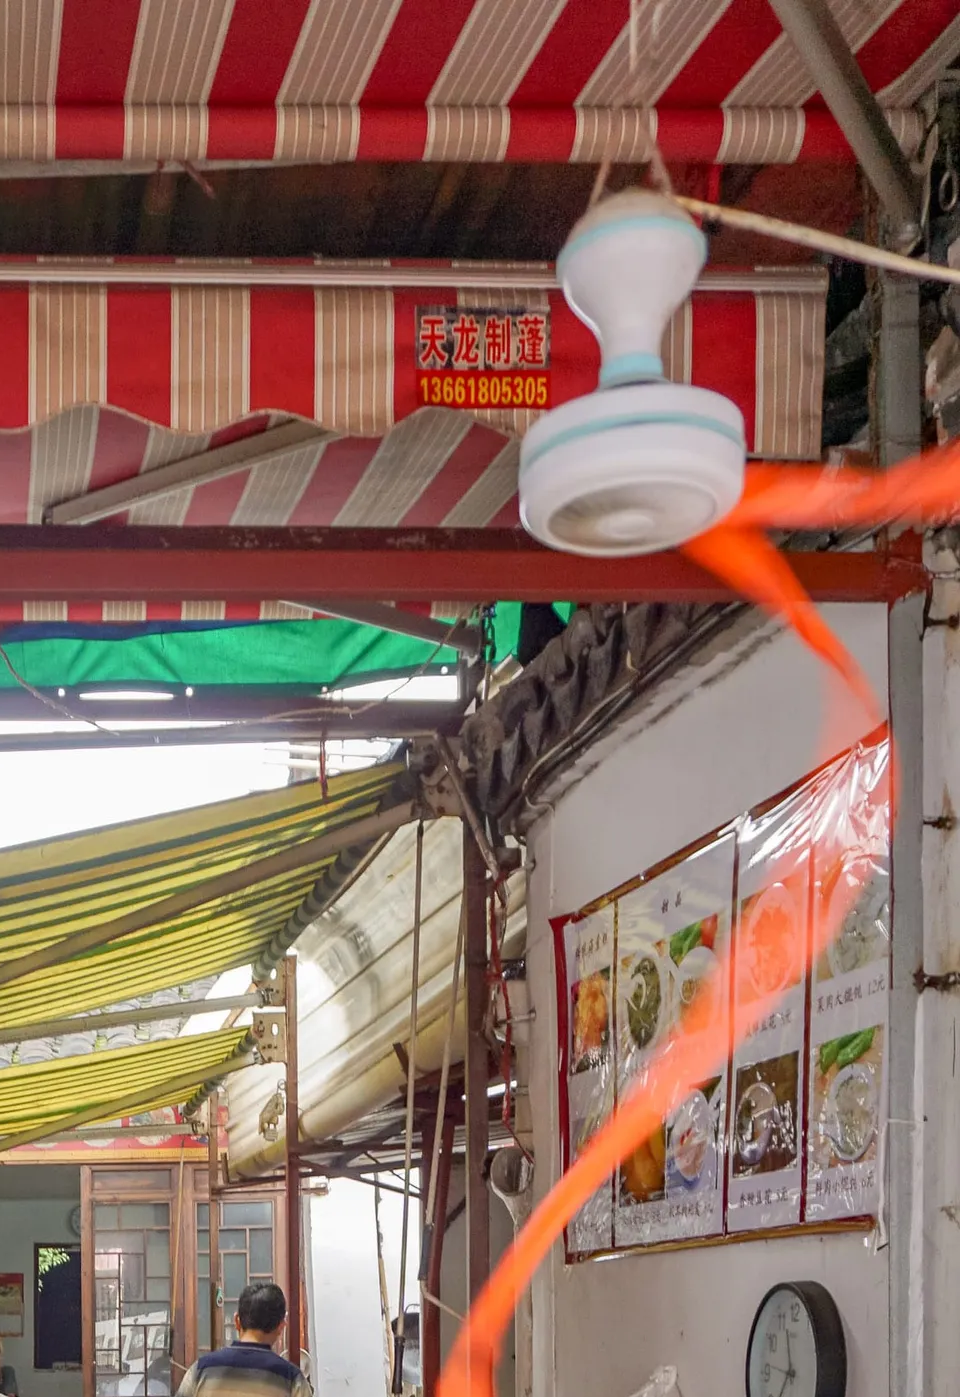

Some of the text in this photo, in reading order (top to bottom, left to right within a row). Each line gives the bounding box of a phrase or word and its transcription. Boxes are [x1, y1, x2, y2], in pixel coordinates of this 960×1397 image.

[420, 316, 545, 365] 天龙制蓬
[420, 376, 548, 405] 13661805305
[778, 1312, 787, 1331] 11
[790, 1302, 801, 1323] 12
[767, 1333, 778, 1353] 10
[763, 1363, 771, 1383] 9
